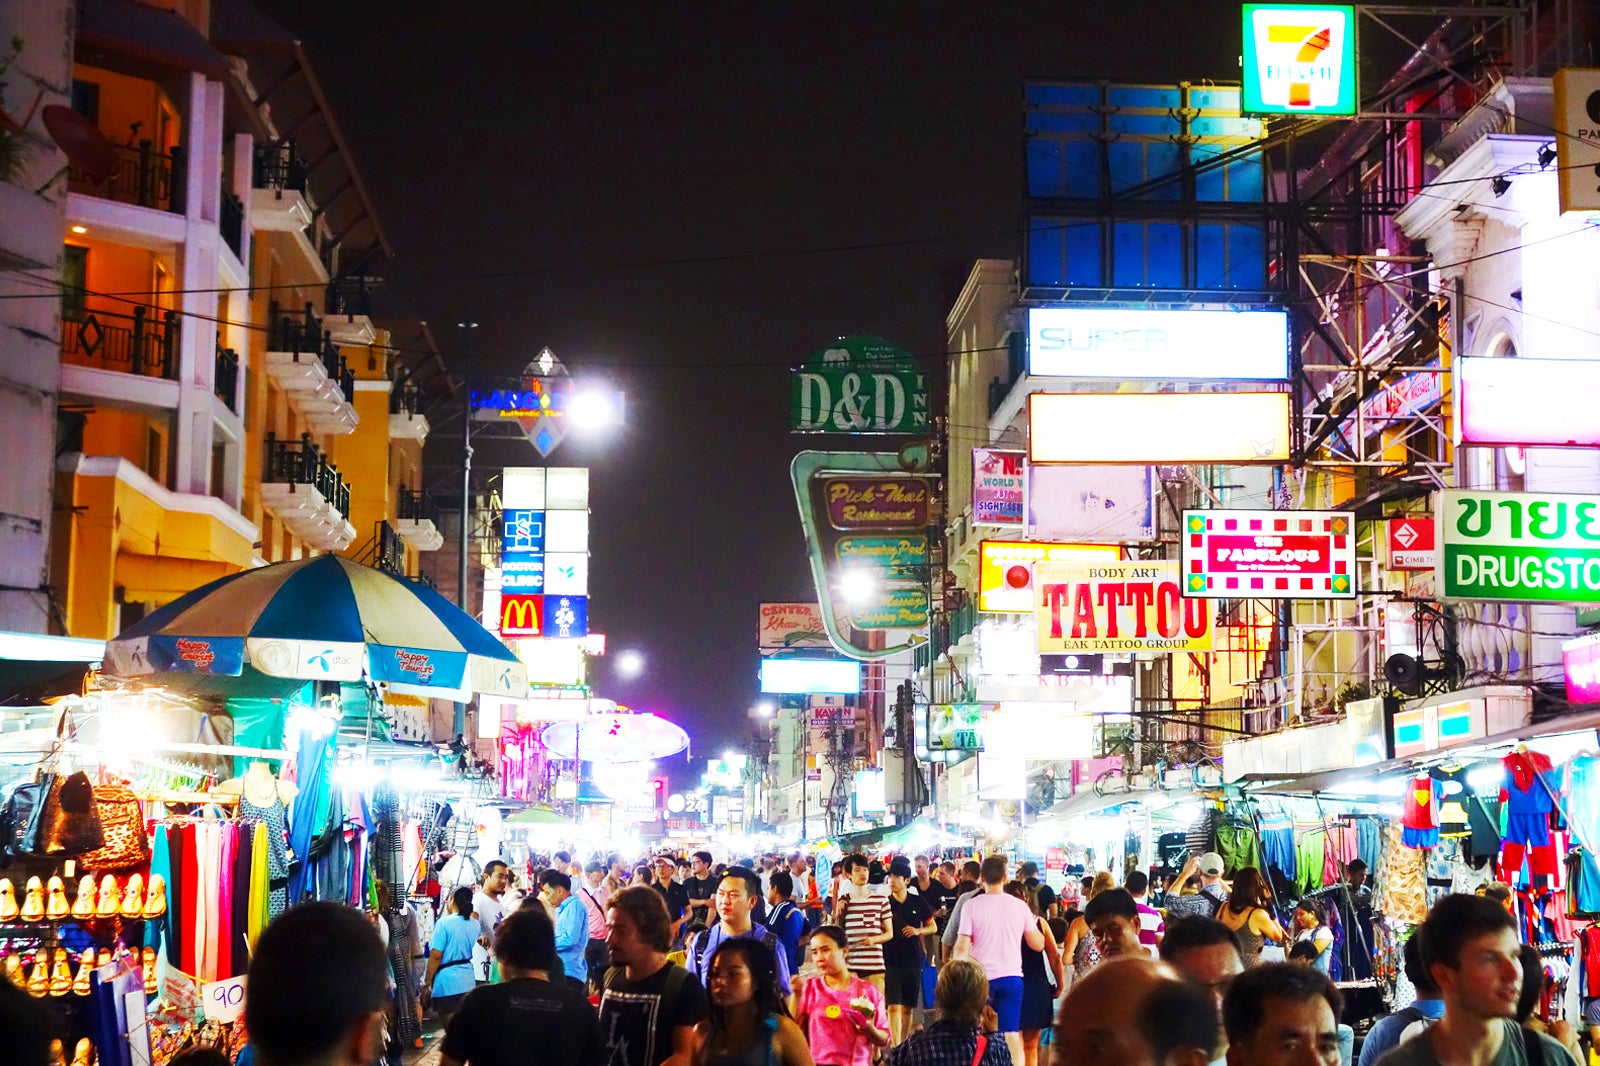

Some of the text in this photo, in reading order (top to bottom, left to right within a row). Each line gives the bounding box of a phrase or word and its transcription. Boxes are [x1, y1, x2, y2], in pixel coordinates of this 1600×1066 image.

[1268, 25, 1330, 106] 7
[1039, 328, 1169, 351] SUPER
[797, 372, 906, 430] D&D
[912, 374, 928, 427] INN
[983, 479, 1014, 487] WORLD
[1254, 537, 1283, 547] THE
[1216, 549, 1320, 562] FABULOUS
[1405, 556, 1425, 564] CIMB
[501, 573, 543, 587] CLINIC
[1089, 568, 1159, 578] BODY ART
[761, 605, 812, 616] CENTER
[1042, 581, 1208, 639] TATTOO
[762, 616, 800, 631] Khao
[176, 639, 210, 655] Happy
[1064, 639, 1189, 649] EAK TATTOO GROUP
[395, 650, 428, 666] Happy
[400, 661, 434, 673] Tourist
[213, 984, 244, 1008] 90
